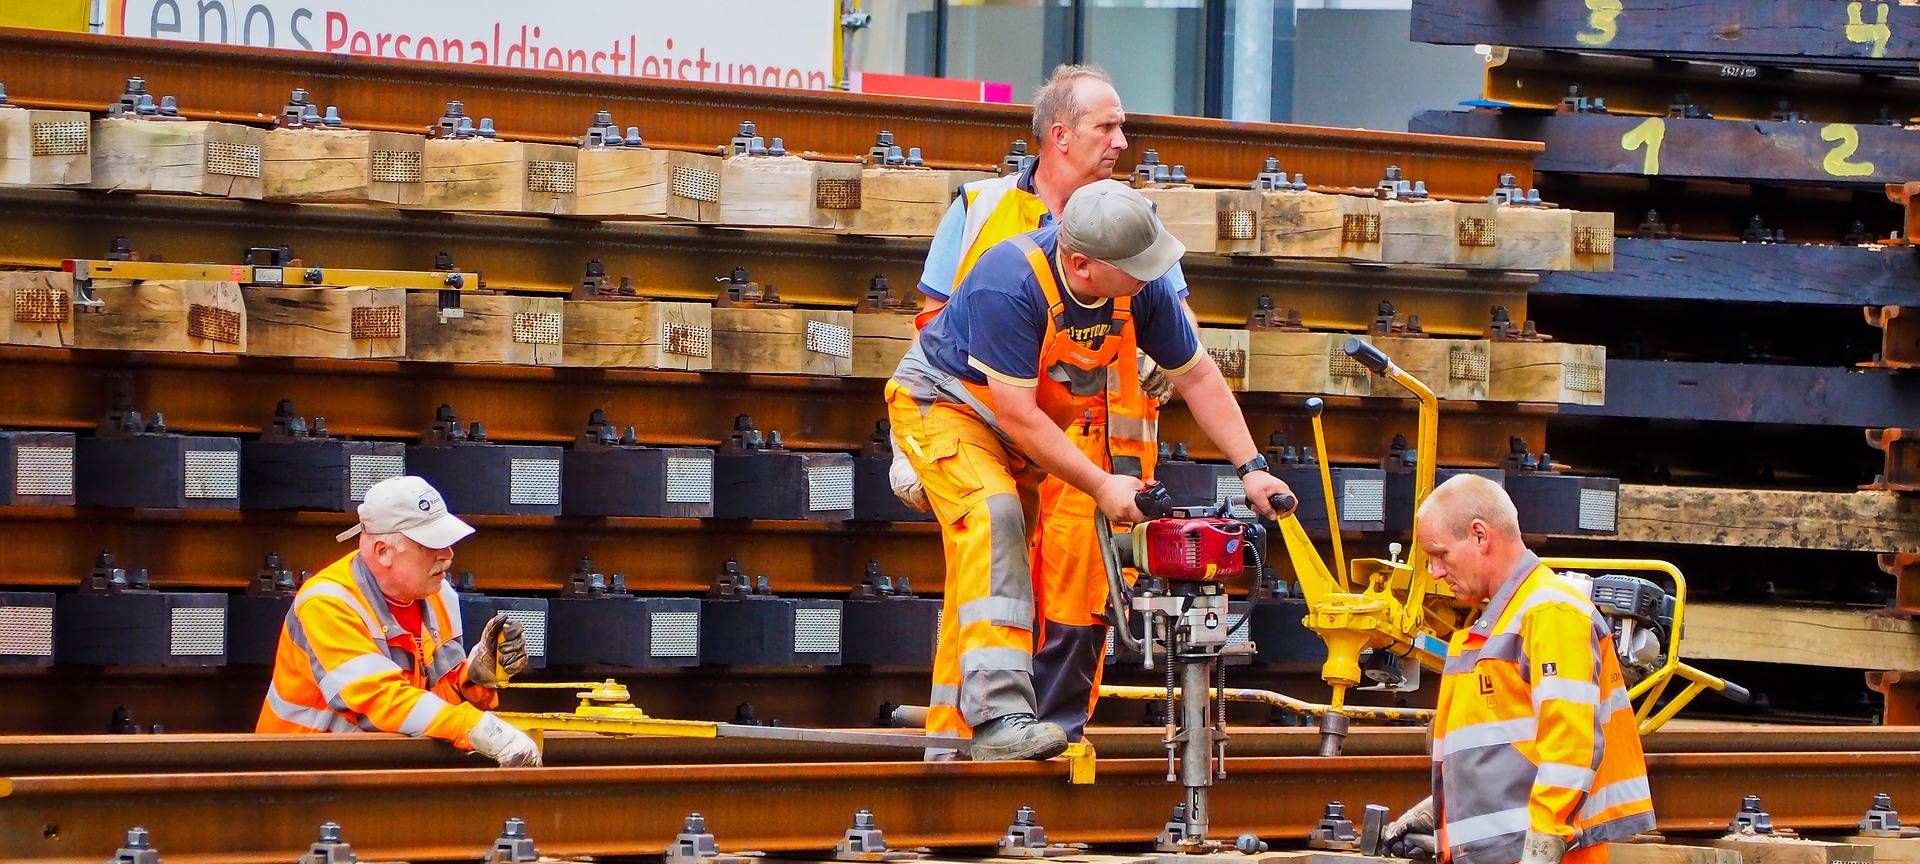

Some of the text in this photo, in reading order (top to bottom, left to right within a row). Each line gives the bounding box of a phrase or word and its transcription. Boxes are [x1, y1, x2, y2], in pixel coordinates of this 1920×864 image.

[1576, 0, 1623, 45] 3
[1846, 2, 1891, 58] 4
[1621, 118, 1665, 175] 1
[1820, 124, 1875, 177] 2
